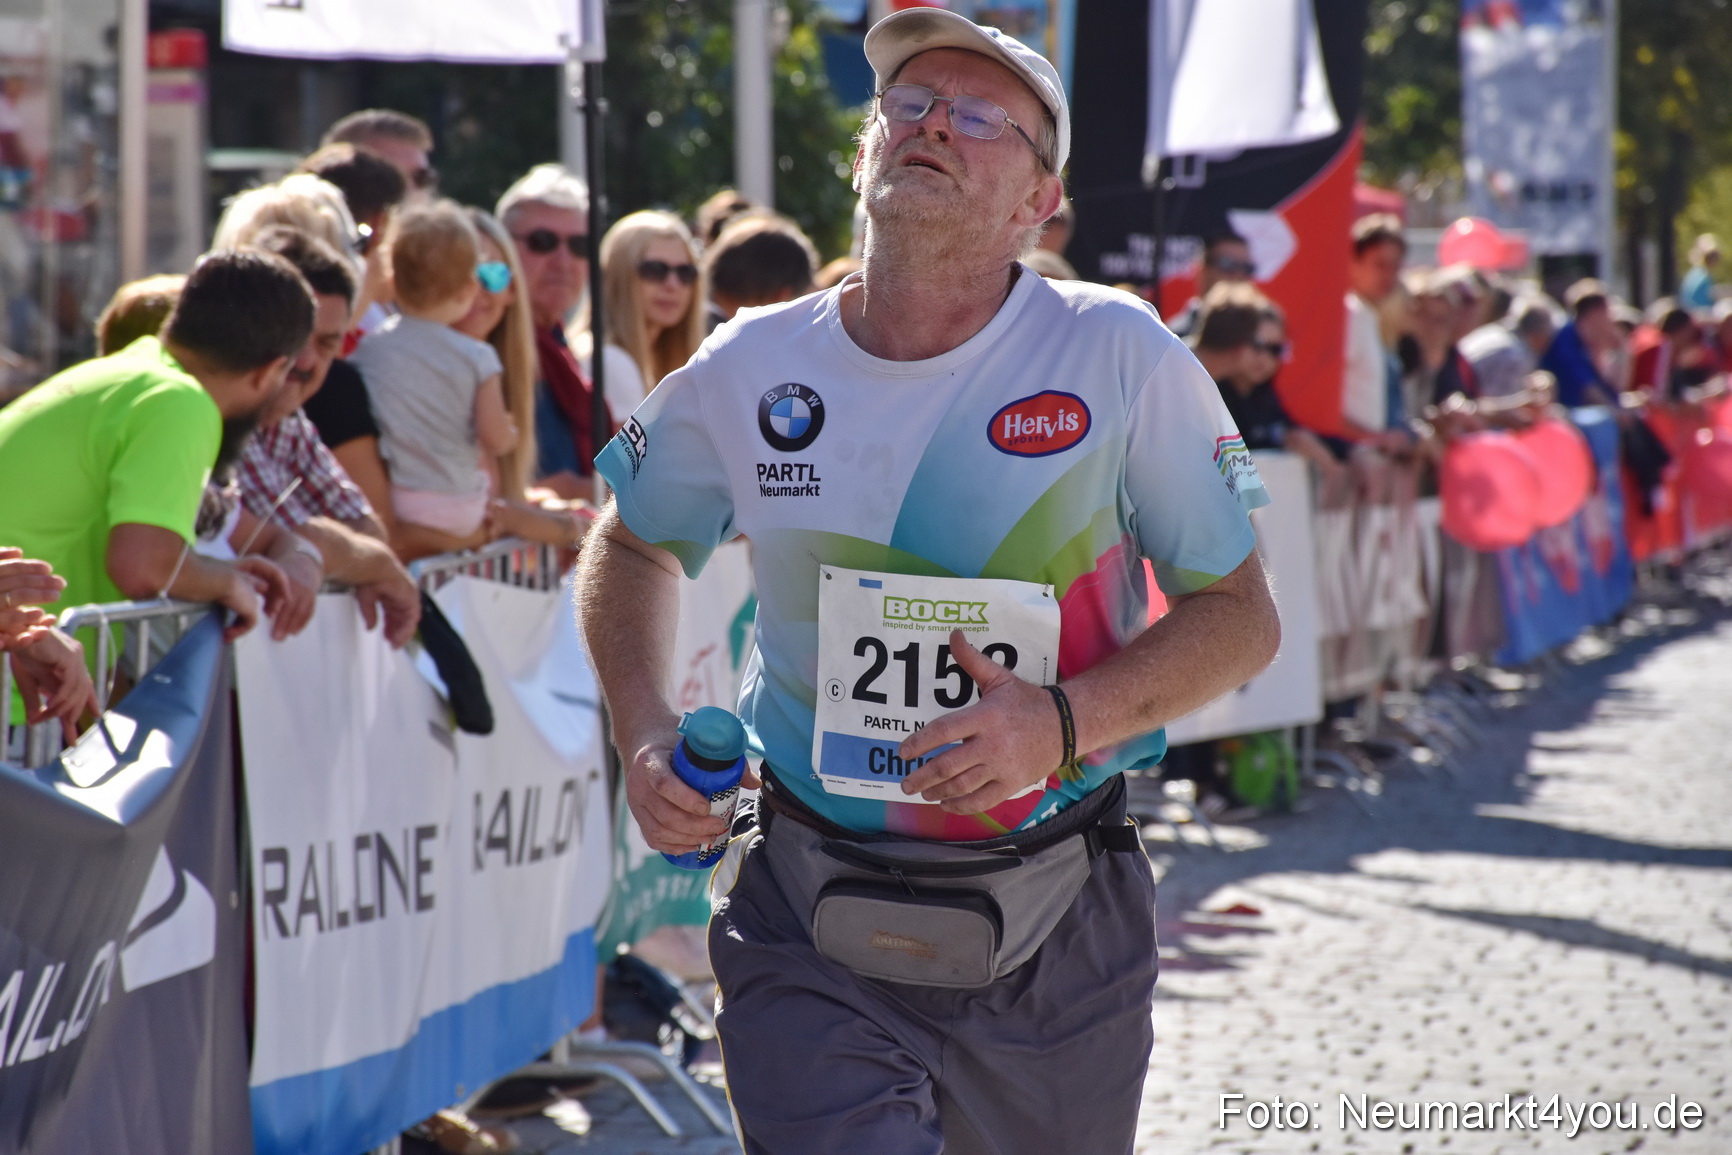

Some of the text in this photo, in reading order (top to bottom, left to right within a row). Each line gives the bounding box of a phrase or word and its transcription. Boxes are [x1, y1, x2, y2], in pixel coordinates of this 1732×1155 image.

[764, 384, 821, 408] BMW
[1003, 408, 1080, 438] Hervis
[1008, 435, 1046, 447] SPORTS
[756, 463, 821, 482] PARTL
[759, 483, 820, 497] Neumarkt
[883, 596, 989, 624] BOCK
[882, 620, 914, 631] inspired
[915, 623, 926, 632] by
[864, 715, 910, 732] PARTL
[868, 746, 934, 777] Chr
